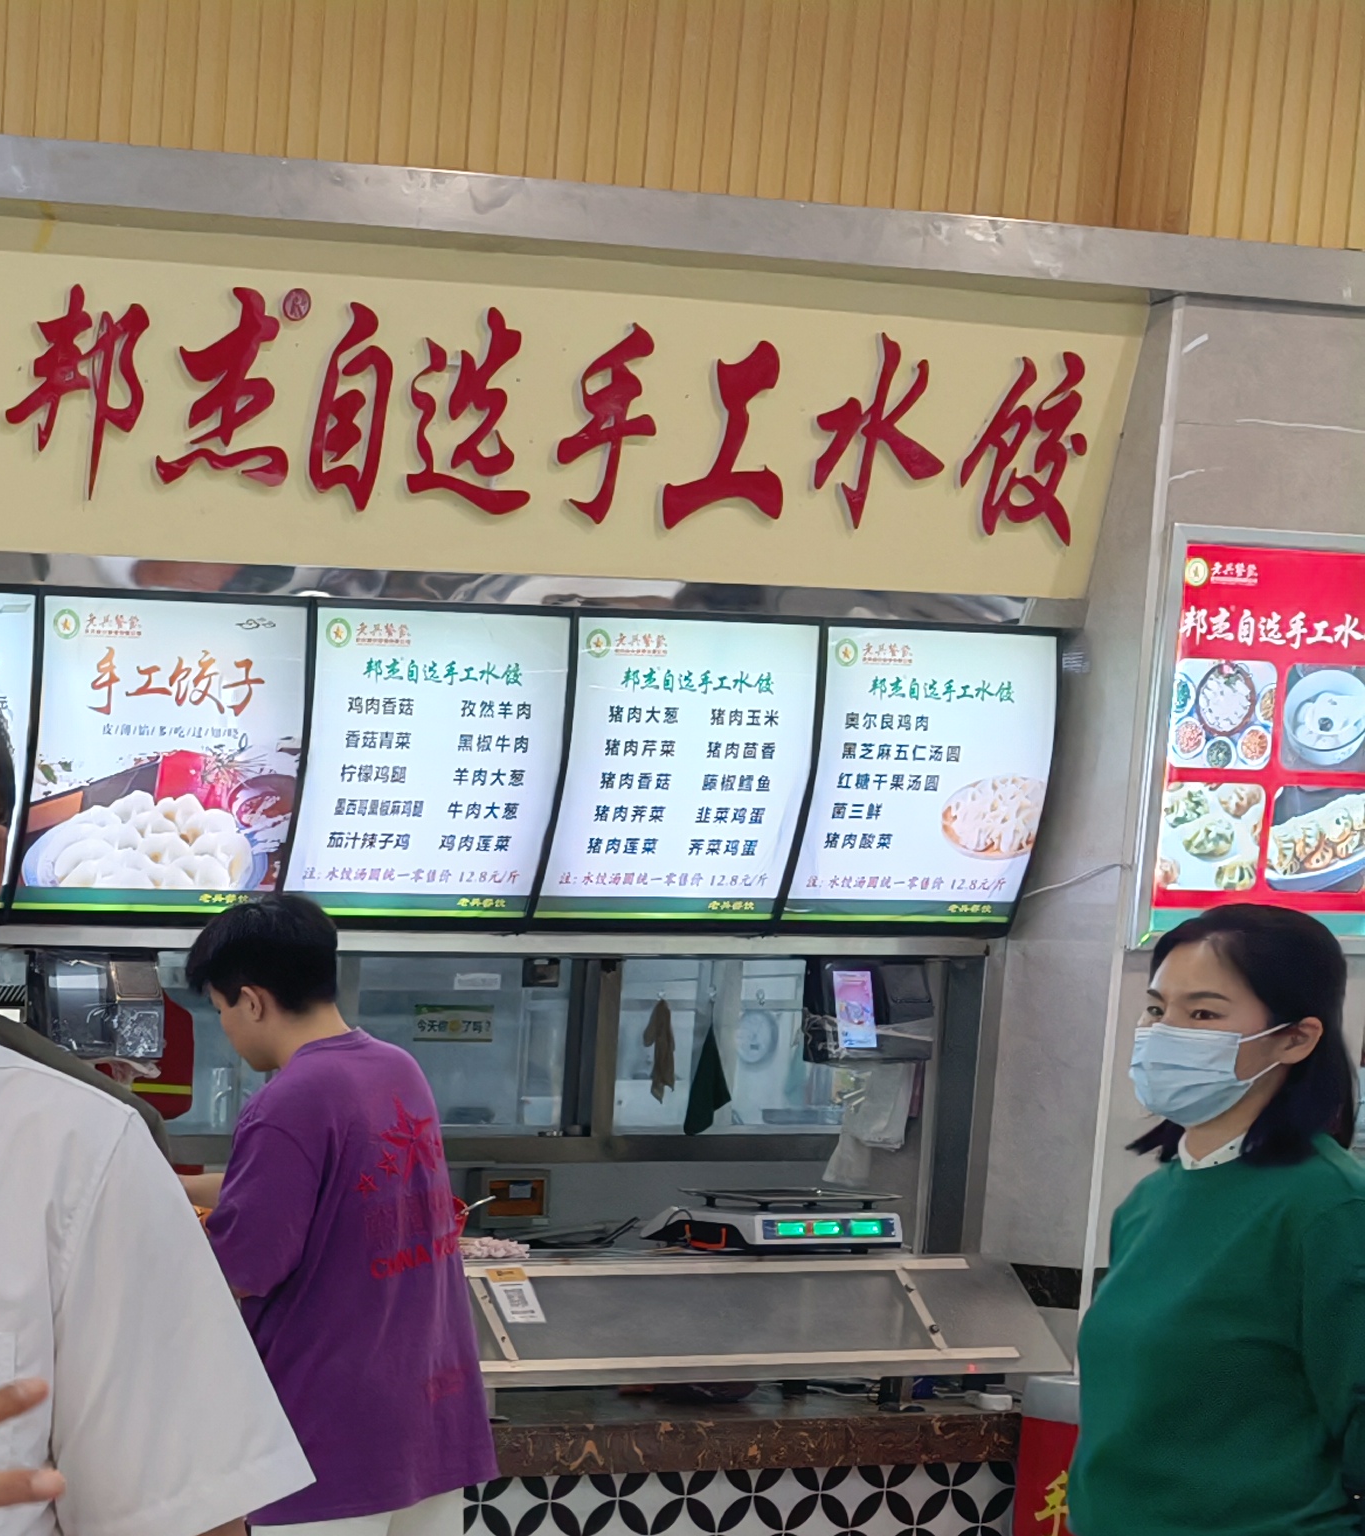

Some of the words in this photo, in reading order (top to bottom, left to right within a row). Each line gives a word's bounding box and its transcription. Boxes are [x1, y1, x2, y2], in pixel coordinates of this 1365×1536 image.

[87, 646, 265, 717] 手工饺子
[347, 697, 414, 716] 鸡肉香菇
[460, 700, 532, 720] 孜然羊肉
[608, 705, 680, 724] 猪肉大葱
[710, 708, 779, 728] 猪肉玉米
[844, 711, 929, 732] 奥尔良鸡肉
[345, 730, 412, 750] 香菇青菜
[457, 734, 529, 754] 黑椒牛肉
[605, 738, 676, 758] 猪肉芹菜
[706, 741, 776, 760] 猪肉茴香
[841, 742, 961, 763] 黑芝麻五仁汤圆
[340, 764, 407, 784] 柠檬鸡腿
[453, 768, 525, 787] 羊肉大葱
[600, 771, 672, 791] 猪肉香菇
[701, 774, 771, 792] 藤椒鳕鱼
[836, 772, 940, 792] 红糖干果汤圆
[447, 801, 519, 820] 牛肉大葱
[594, 805, 666, 823] 猪肉荠菜
[695, 807, 766, 825] 韭菜鸡蛋
[831, 803, 883, 820] 菌三鲜
[327, 831, 410, 850] 茄汁辣子鸡
[438, 833, 512, 852] 鸡肉莲菜
[587, 837, 658, 855] 猪肉莲菜
[688, 839, 758, 857] 荠菜鸡蛋
[824, 832, 893, 850] 猪肉酸菜
